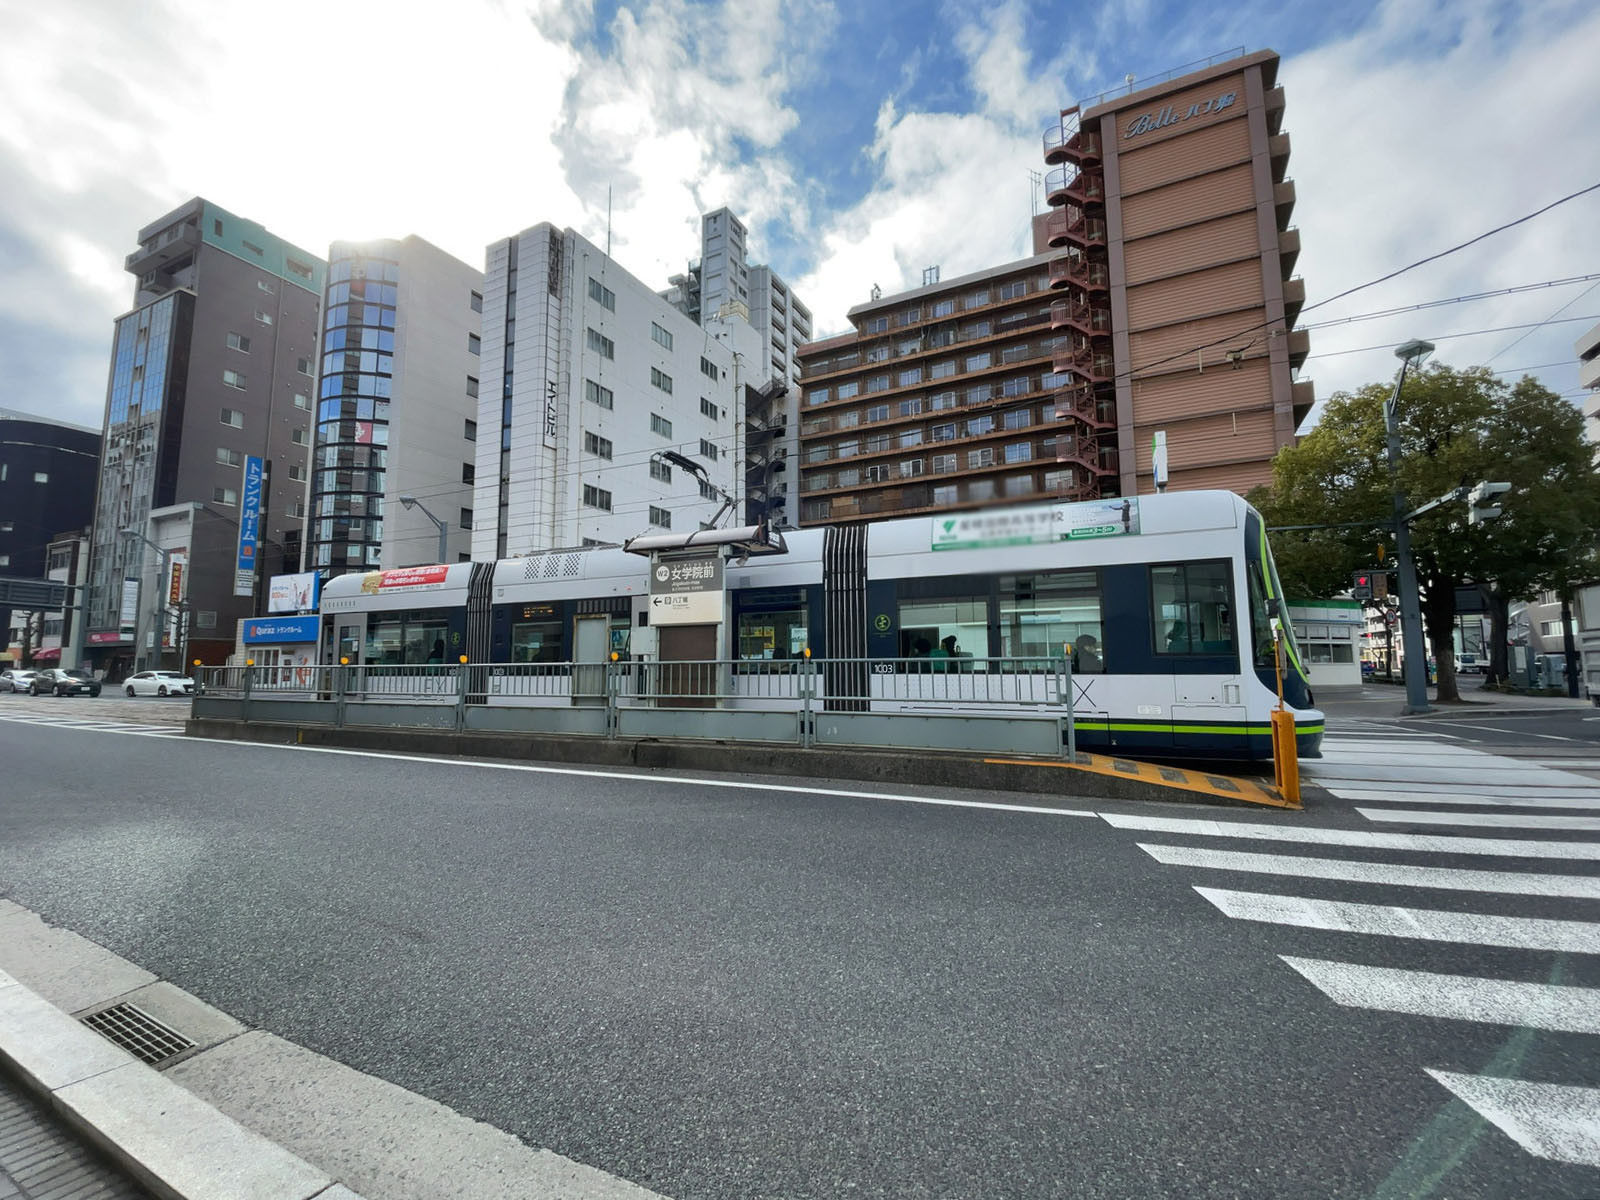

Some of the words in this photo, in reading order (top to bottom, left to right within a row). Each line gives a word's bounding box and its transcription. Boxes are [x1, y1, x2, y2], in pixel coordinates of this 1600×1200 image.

[1124, 105, 1180, 139] Belle
[546, 380, 557, 436] エイトビル
[242, 464, 259, 541] トランクルーム
[671, 565, 714, 581] 女学院前
[874, 664, 893, 673] 1003
